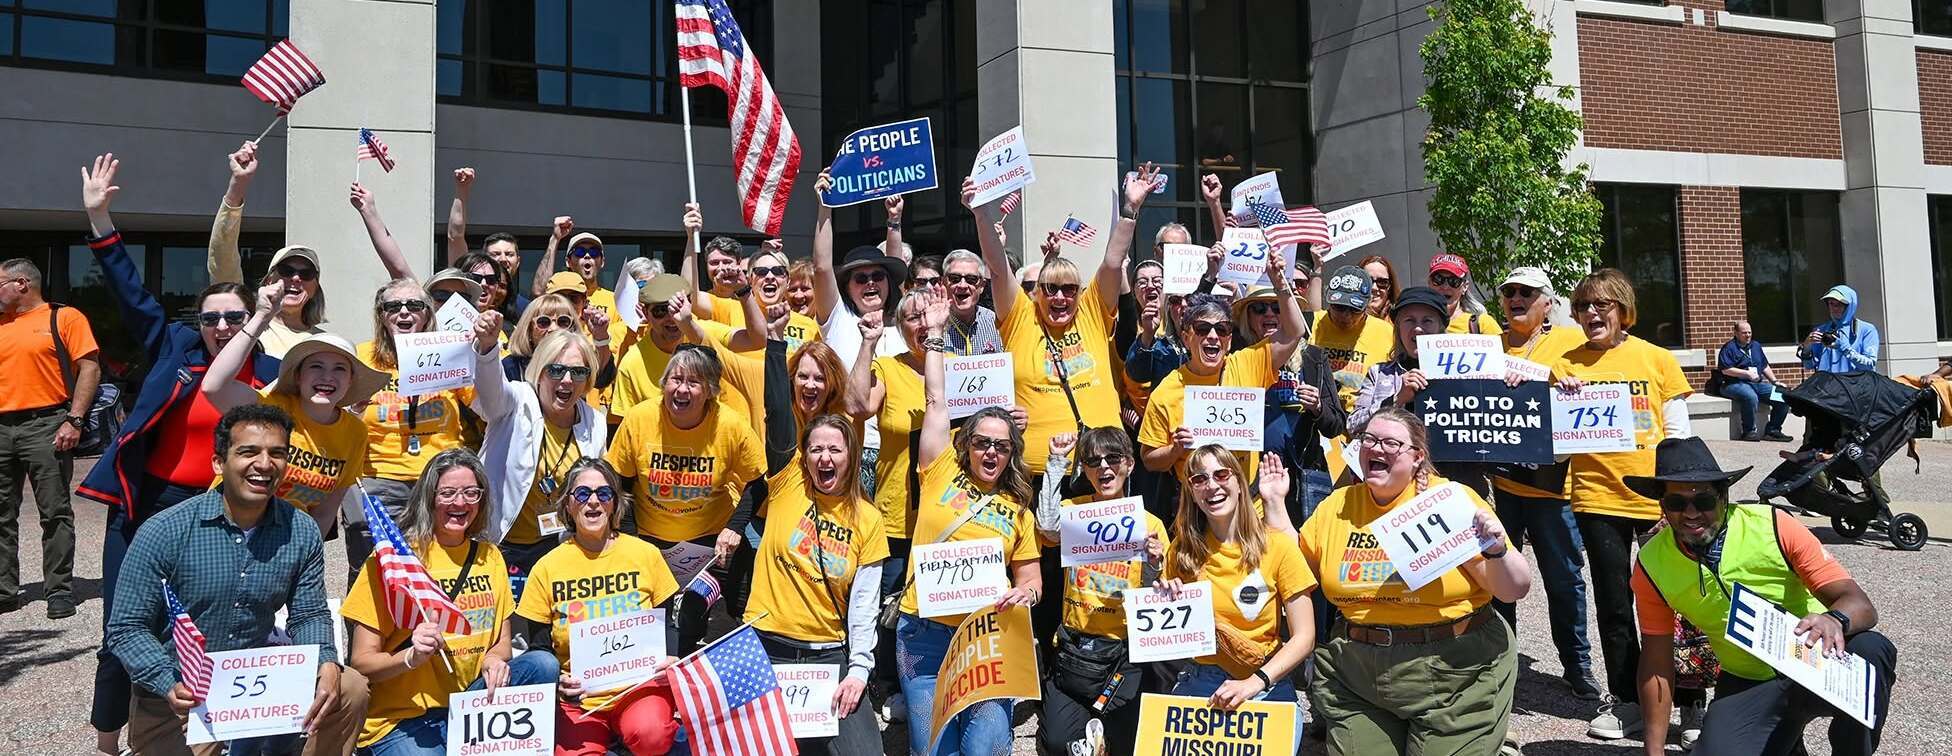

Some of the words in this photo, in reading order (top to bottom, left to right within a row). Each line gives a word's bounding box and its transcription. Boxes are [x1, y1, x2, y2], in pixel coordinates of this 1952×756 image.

[860, 126, 921, 153] PEOPLE
[976, 166, 1025, 194] SIGNATURES
[1435, 339, 1494, 348] COLLECTED
[953, 358, 1006, 372] COLLECTED
[1436, 352, 1487, 375] 467
[408, 368, 468, 384] SIGNATURES
[958, 376, 987, 394] 168
[948, 394, 1008, 408] SIGNATURES
[1193, 392, 1196, 400] I
[1200, 392, 1256, 401] COLLECTED
[1450, 396, 1481, 410] NO
[1485, 396, 1514, 411] TO
[1556, 390, 1620, 402] COLLECTED
[1206, 406, 1246, 425] 365
[1424, 412, 1541, 428] POLITICIAN
[1568, 405, 1618, 429] 754
[1192, 428, 1254, 438] SIGNATURES
[1444, 430, 1522, 445] TRICKS
[1553, 428, 1624, 440] SIGNATURES
[650, 452, 715, 472] RESPECT
[648, 470, 712, 486] MISSOURI
[649, 484, 712, 499] VOTERS
[1070, 512, 1073, 520] I
[1078, 502, 1136, 520] COLLECTED
[1381, 525, 1388, 534] I
[1390, 488, 1454, 528] COLLECTED
[1087, 516, 1136, 545] 909
[1400, 512, 1452, 554] 119
[923, 552, 927, 560] I
[932, 544, 994, 560] COLLECTED
[1072, 542, 1138, 554] SIGNATURES
[1409, 526, 1478, 572] SIGNATURES
[920, 561, 951, 574] FIELD
[552, 571, 641, 602] RESPECT
[928, 586, 998, 603] SIGNATURES
[1135, 596, 1138, 604] I
[1144, 588, 1203, 604] COLLECTED
[580, 628, 584, 638] I
[590, 614, 656, 636] COLLECTED
[966, 612, 1000, 642] THE
[1136, 605, 1192, 632] 527
[600, 634, 636, 658] 162
[1140, 632, 1206, 648] SIGNATURES
[221, 653, 306, 670] COLLECTED
[583, 655, 657, 680] SIGNATURES
[230, 674, 269, 698] 55
[942, 661, 1006, 717] DECIDE
[461, 700, 465, 710] I
[472, 692, 545, 708] COLLECTED
[204, 704, 300, 724] SIGNATURES
[1164, 706, 1268, 740] RESPECT
[460, 738, 542, 756] SIGNATURES
